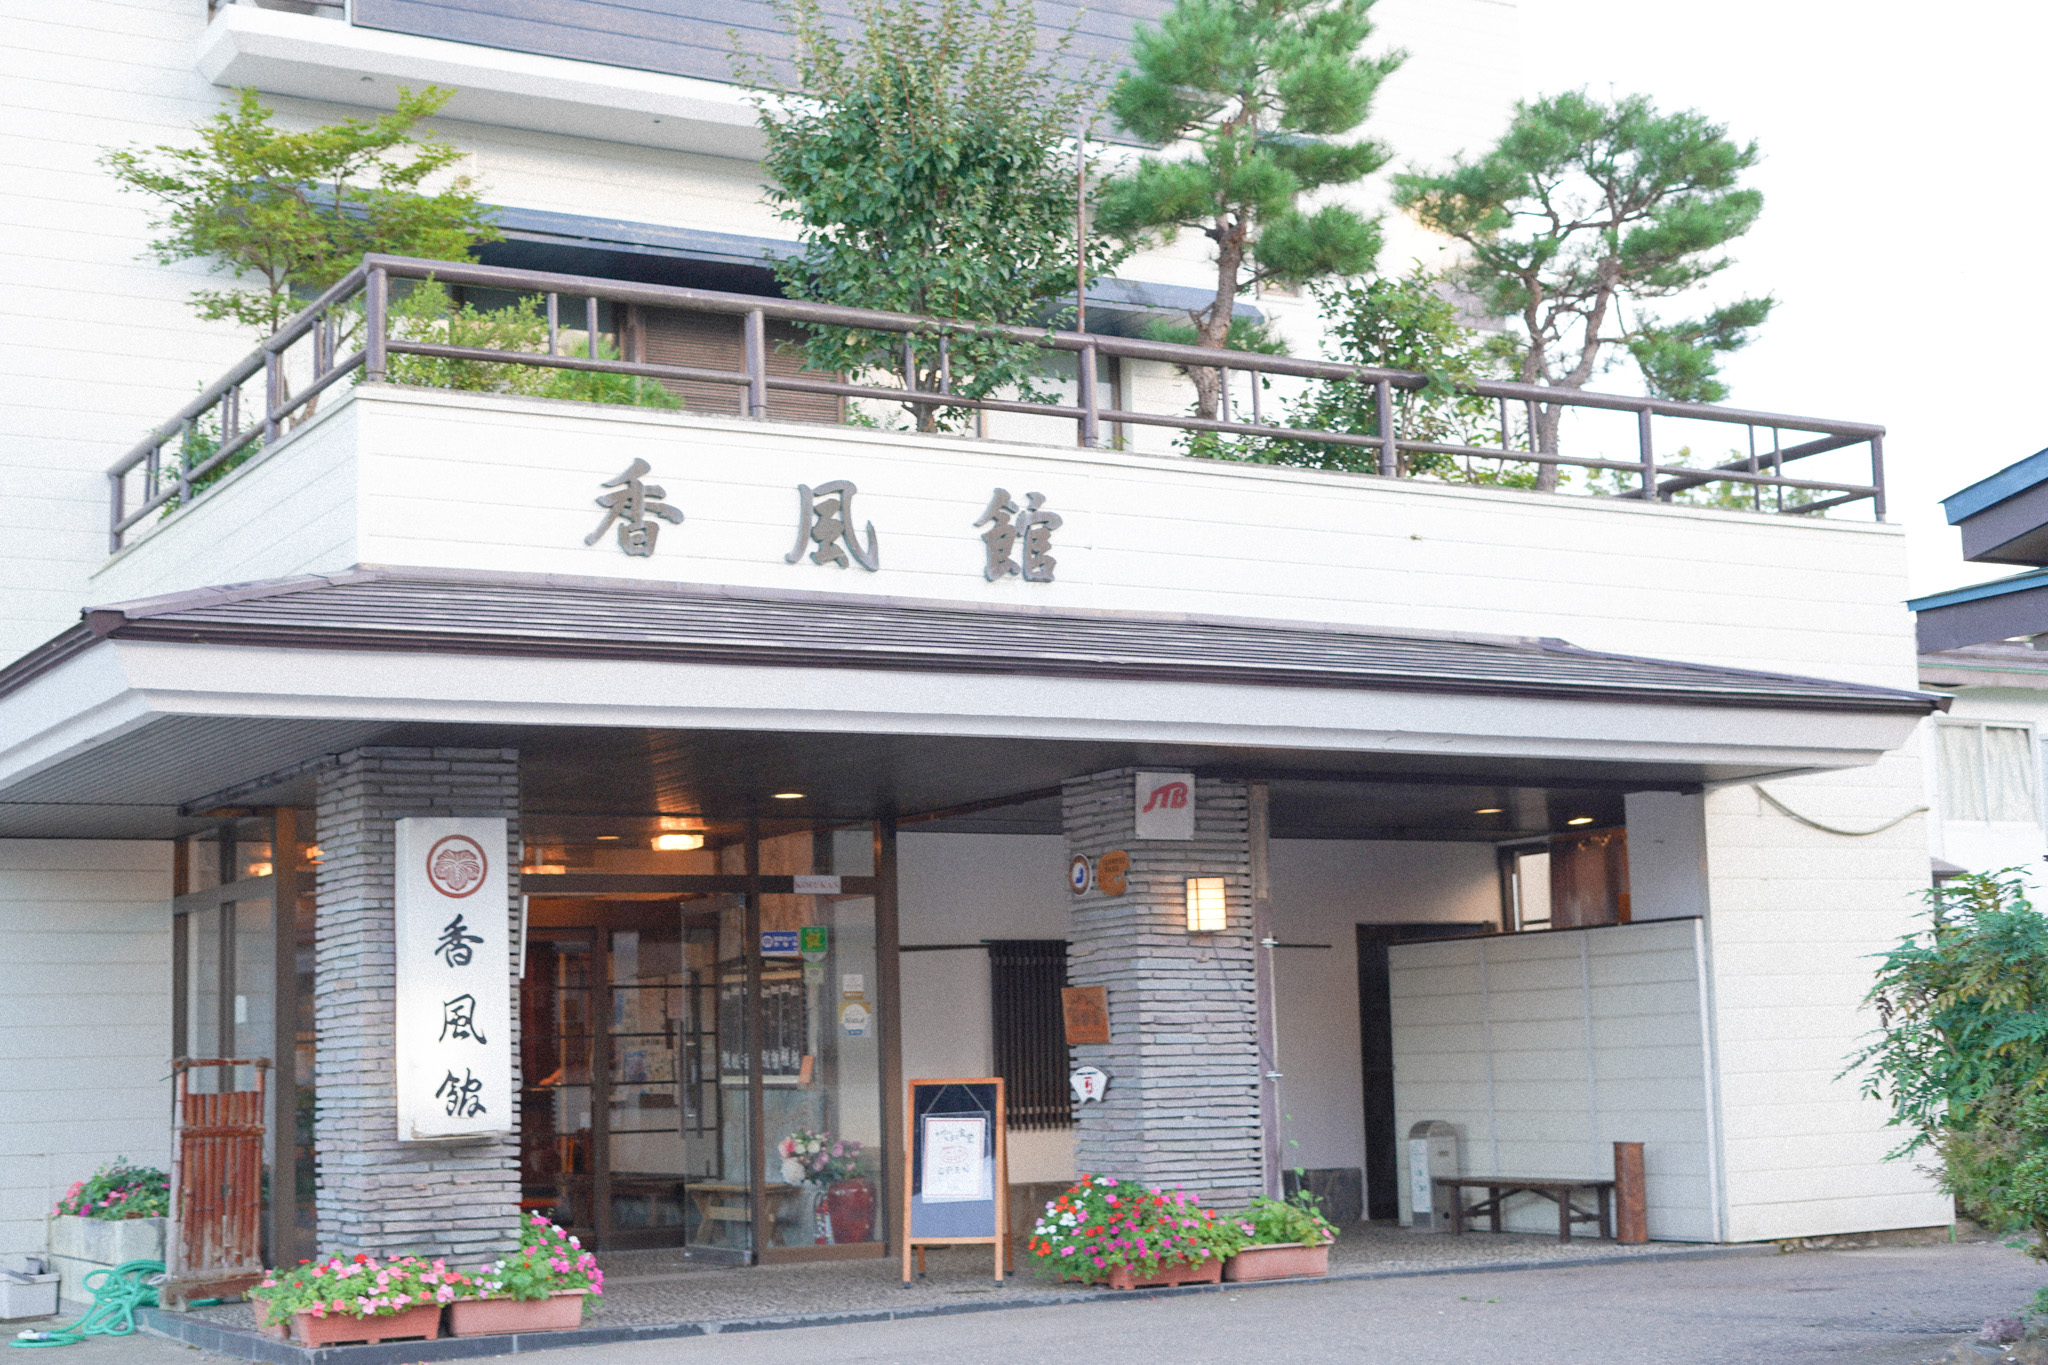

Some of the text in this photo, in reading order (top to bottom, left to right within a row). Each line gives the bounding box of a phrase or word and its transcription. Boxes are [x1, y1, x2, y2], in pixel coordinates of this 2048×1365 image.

[585, 457, 1063, 583] 香風館
[1142, 781, 1188, 813] JTB
[434, 913, 488, 1118] 香風館
